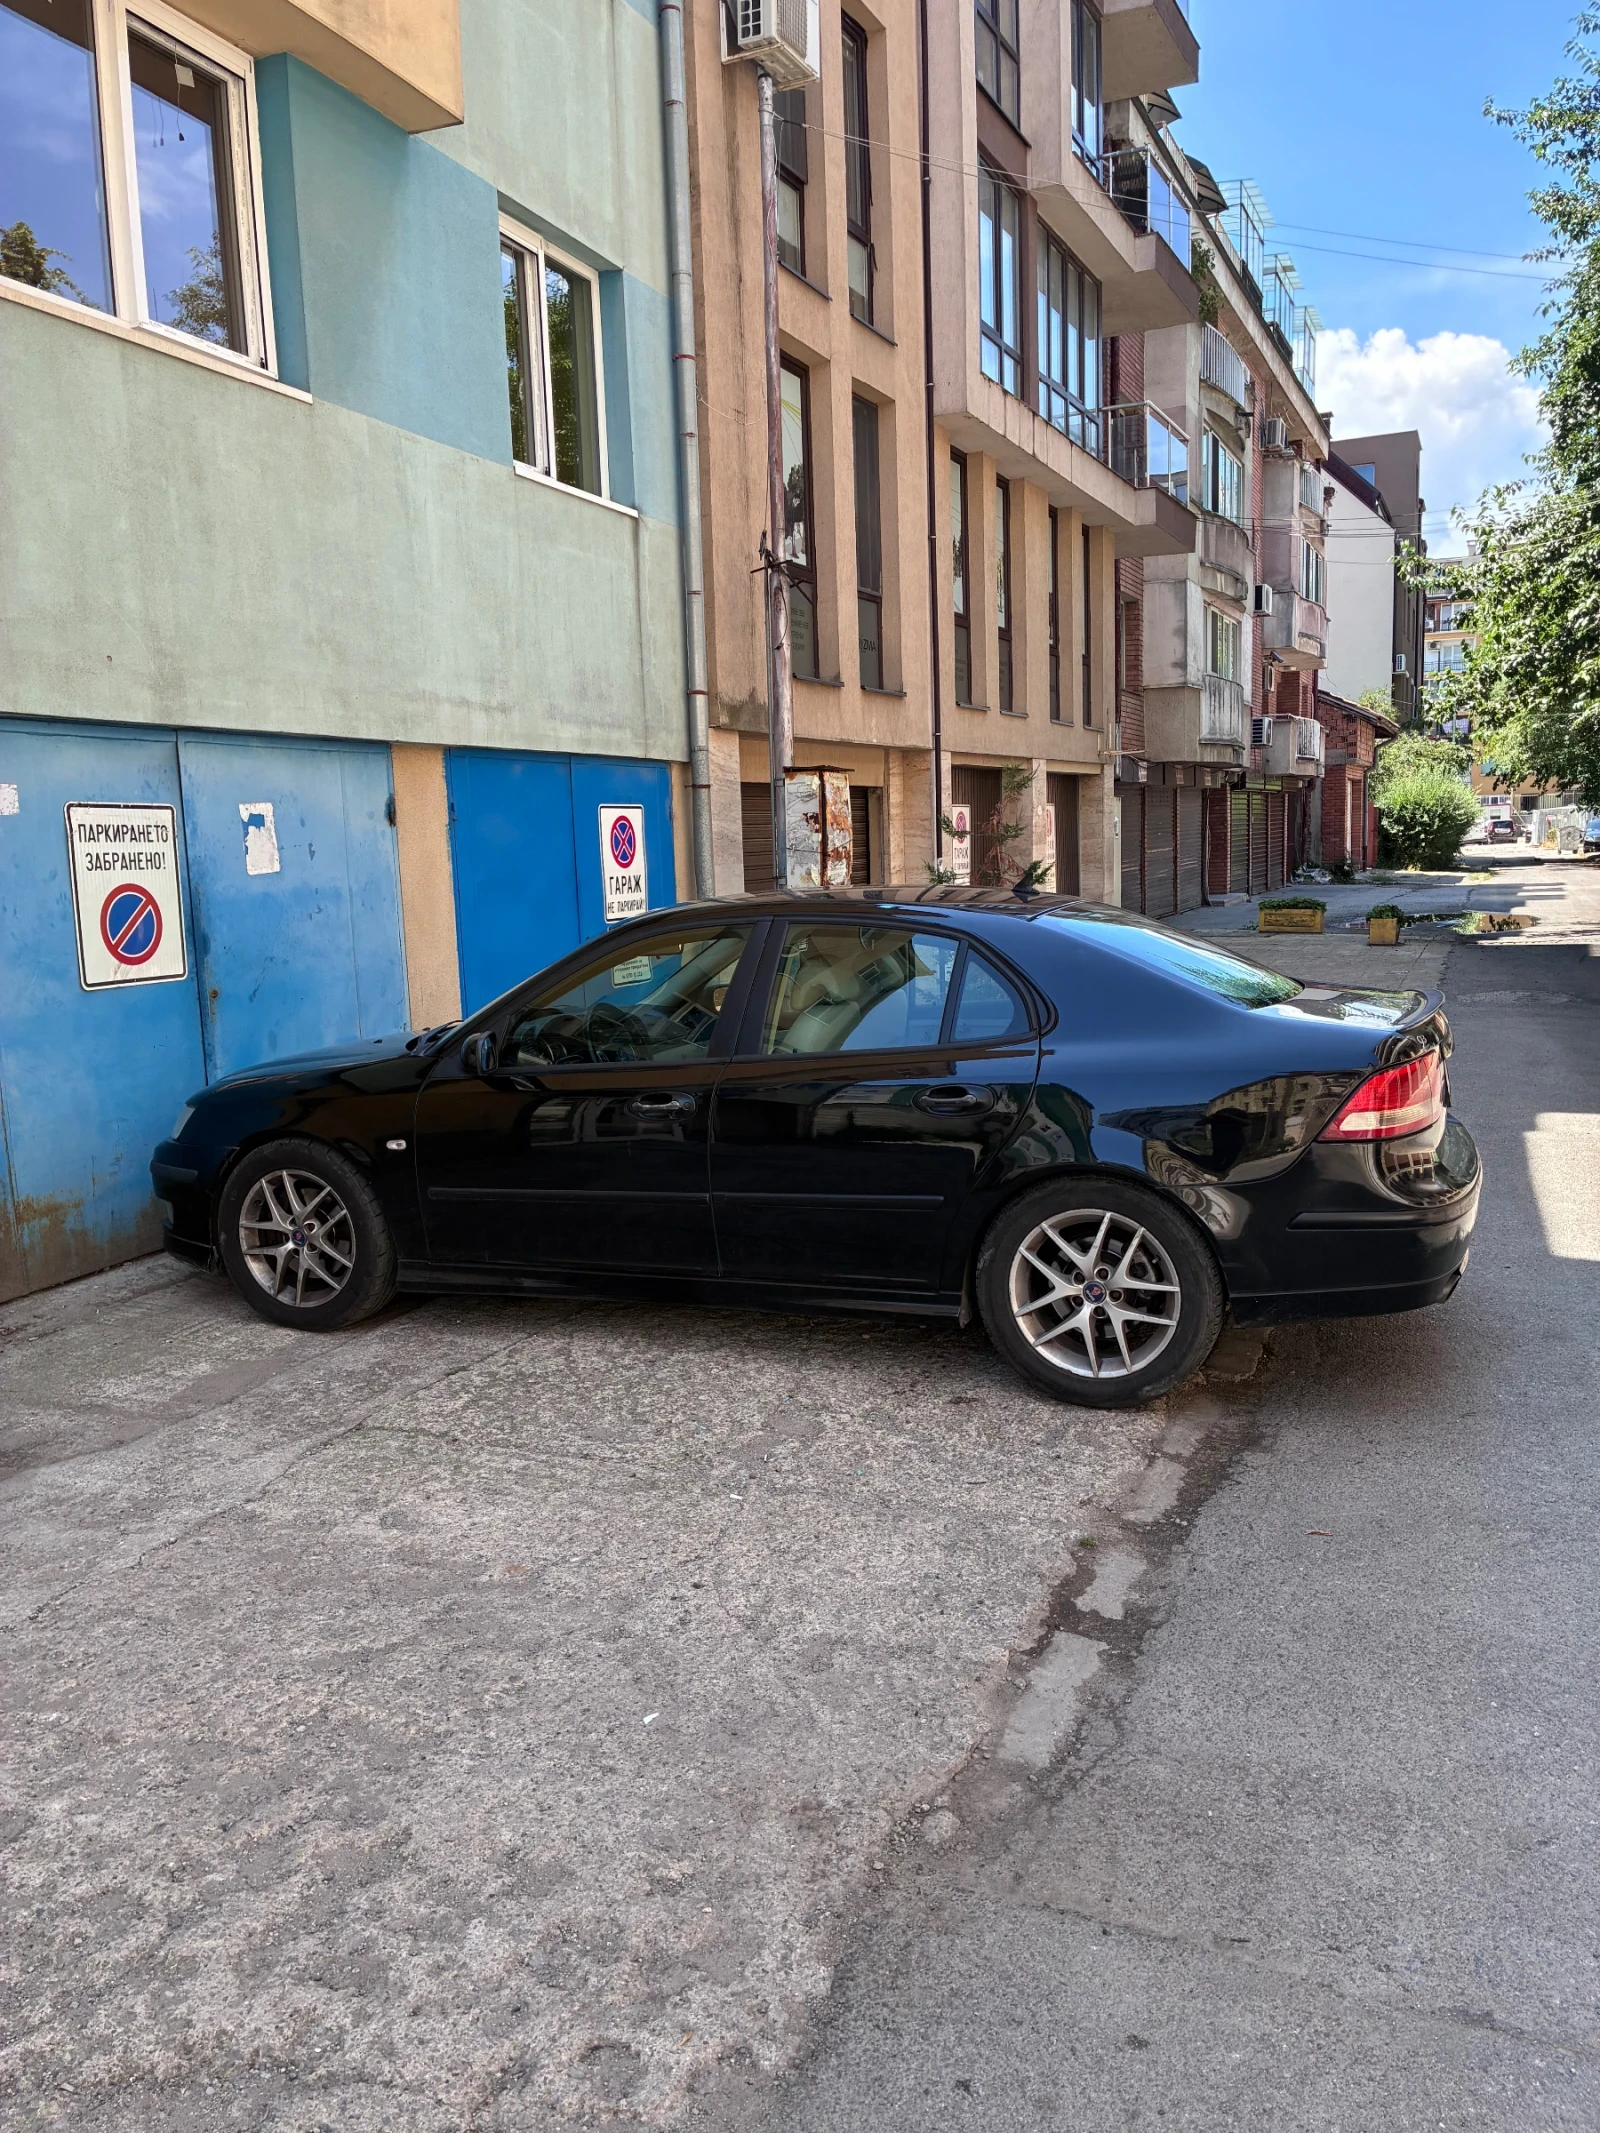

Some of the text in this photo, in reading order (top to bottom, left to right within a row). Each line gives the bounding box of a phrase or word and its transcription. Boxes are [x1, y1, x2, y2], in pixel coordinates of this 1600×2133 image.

[77, 823, 169, 843] ПАРКИРАНЕТО
[85, 852, 166, 871] ЗАБРАНЕНО!
[609, 874, 642, 895] ГАРАЖ
[607, 901, 615, 914] НЕ
